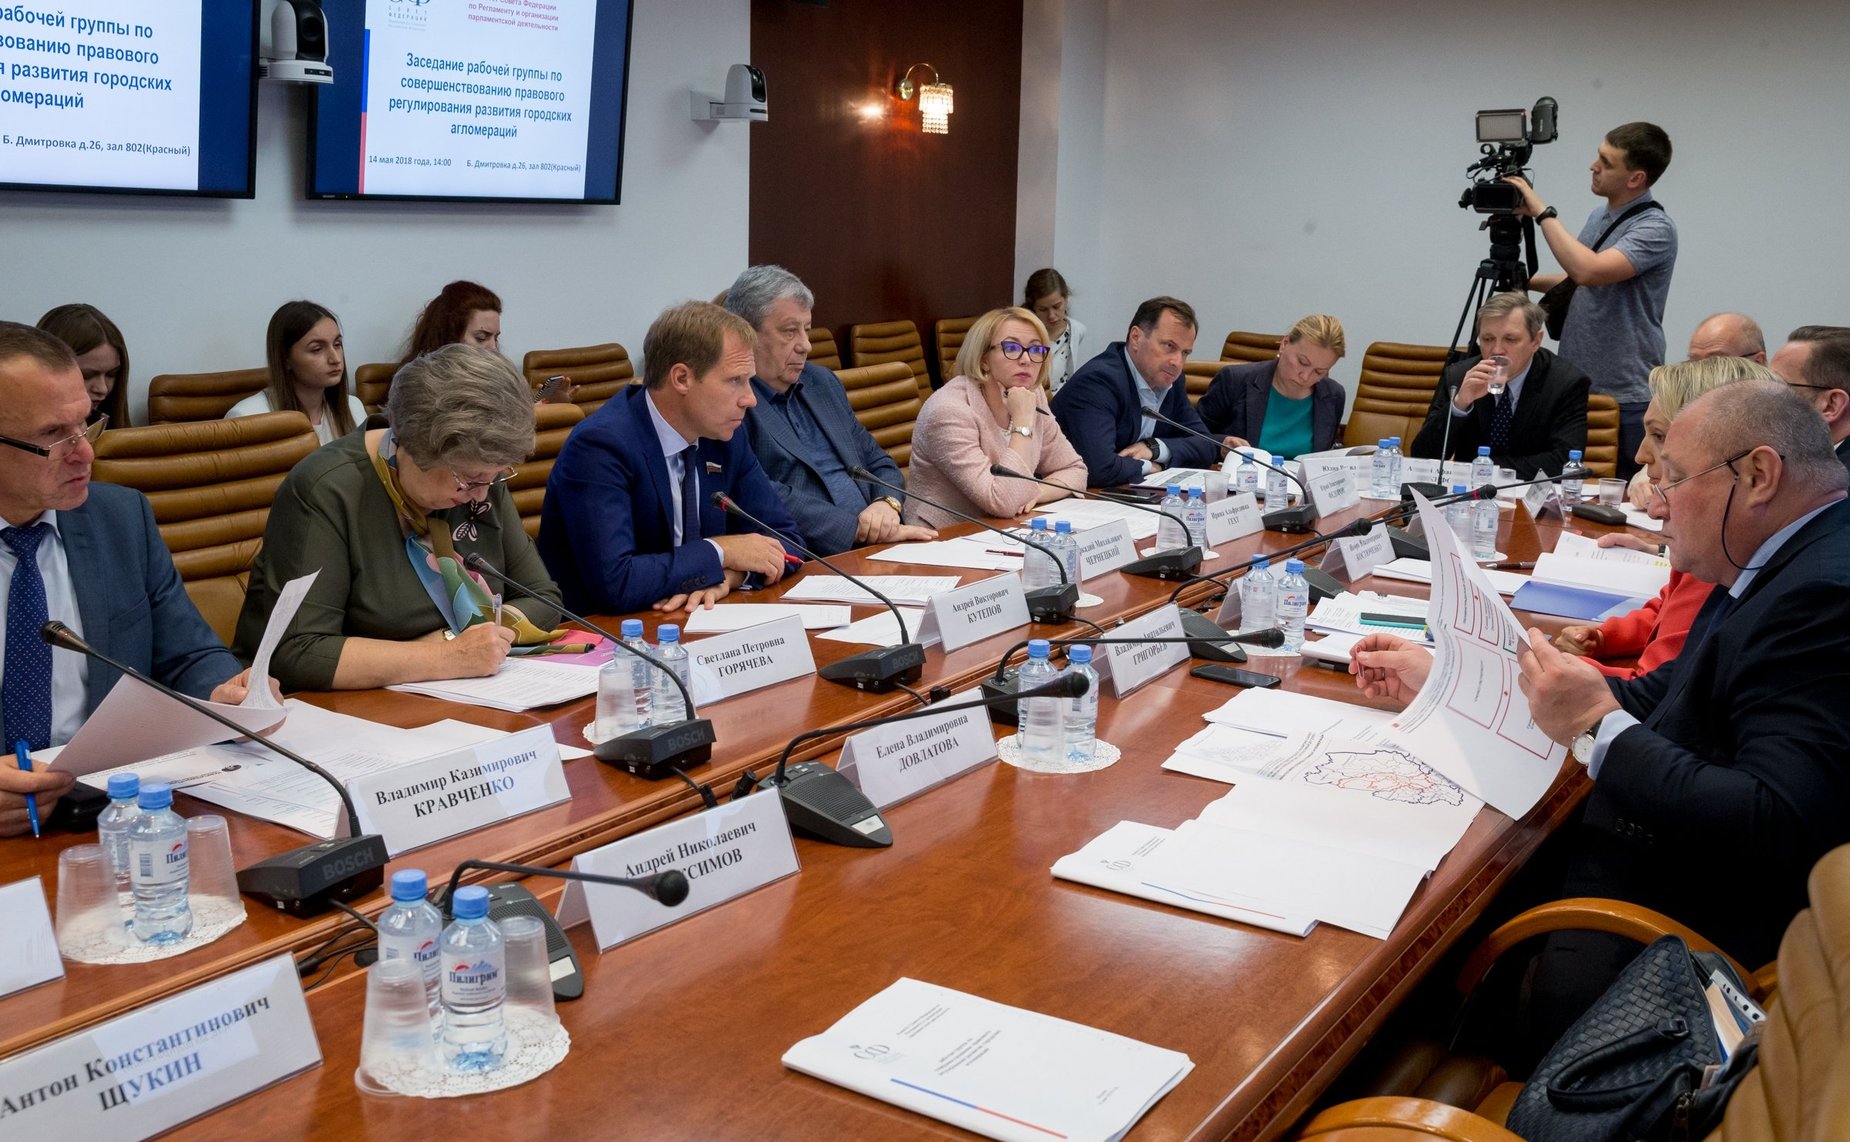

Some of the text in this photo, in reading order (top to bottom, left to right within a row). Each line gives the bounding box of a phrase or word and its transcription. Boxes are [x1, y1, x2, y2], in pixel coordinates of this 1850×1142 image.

[71, 16, 129, 36] группы
[135, 25, 153, 38] по
[517, 21, 559, 31] деятельности
[521, 11, 559, 22] организации
[77, 44, 159, 64] правового
[11, 62, 88, 83] развития
[94, 72, 172, 91] городских
[406, 52, 562, 82] Заседание рабочей группы по
[1, 89, 84, 109] омераций
[400, 77, 565, 102] совершенствованию правового
[389, 97, 572, 122] регулирования развития городских
[450, 123, 517, 139] агломераций
[3, 134, 191, 156] Б. Дмитровка д.26, зал 802(Красный)
[369, 155, 378, 163] 14
[395, 156, 413, 165] 2018
[413, 158, 432, 167] года,
[433, 158, 452, 167] 14:00
[466, 160, 473, 168] Б.
[474, 160, 511, 170] Дмитровка
[512, 162, 527, 171] д.26,
[540, 163, 581, 173] 802(Красный)
[1094, 534, 1123, 548] Михайлович
[1085, 544, 1121, 565] ЧЕРНЕЦКИЙ
[952, 588, 1009, 613] Андрей Викторович
[967, 604, 1002, 624] КУТЕПОВ
[696, 637, 785, 666] Светлана Петровна
[1132, 642, 1168, 665] ГРИГОРЬЕВ
[718, 655, 774, 677] ГОРЯЧЕВА
[668, 727, 705, 750] BOSCH
[876, 714, 969, 759] Елена Владимировна
[899, 736, 960, 773] ДОВЛАТОВА
[375, 750, 538, 806] Владимир Казимирович
[413, 775, 515, 818] КРАВЧЕНКО
[625, 821, 757, 880] Андрей Николаевич
[323, 847, 375, 880] BOSCH
[683, 847, 743, 880] СИМОВ
[448, 968, 499, 986] Пилигрим
[0, 996, 271, 1119] Антон Константинович
[98, 1051, 203, 1112] ЩУКИН
